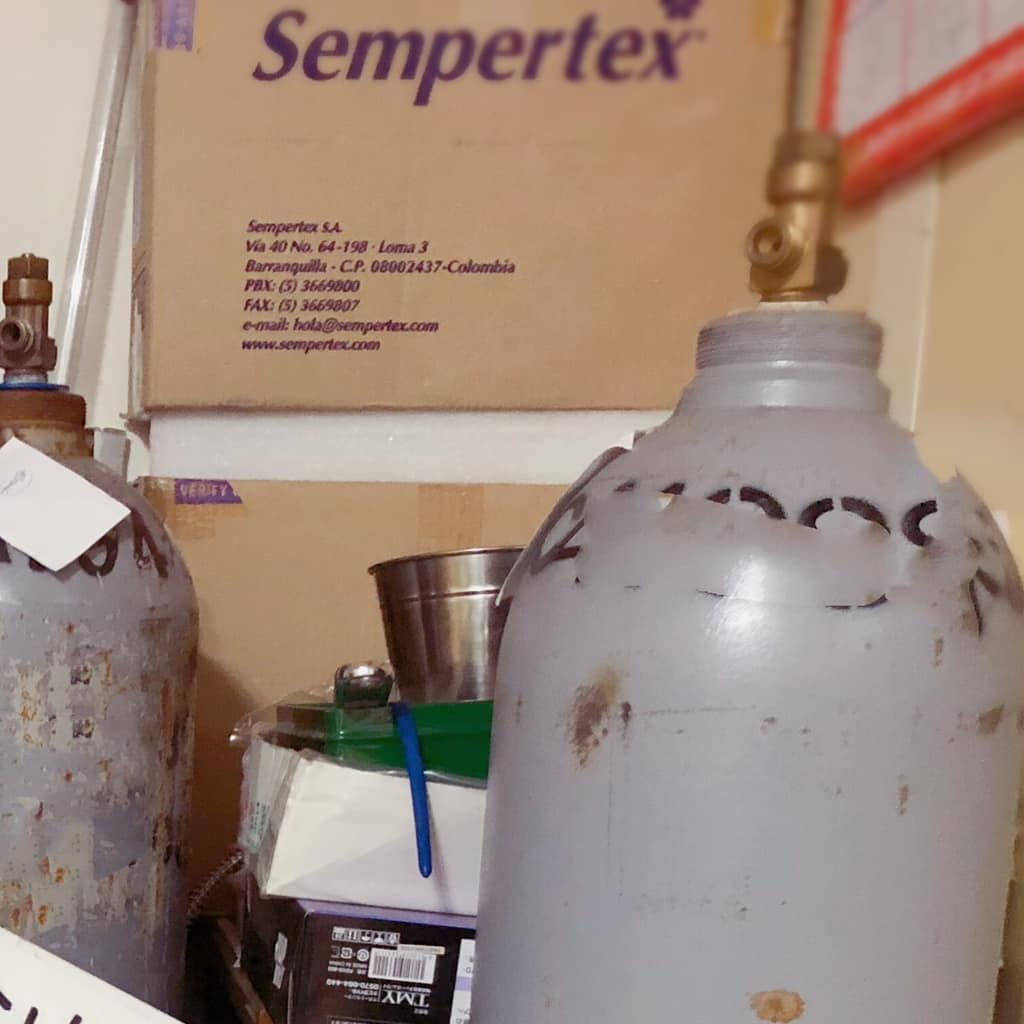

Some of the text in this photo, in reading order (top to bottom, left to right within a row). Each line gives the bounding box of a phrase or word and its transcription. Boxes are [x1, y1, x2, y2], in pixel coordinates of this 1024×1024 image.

[252, 10, 691, 106] Sempertex
[247, 219, 318, 236] Sempertex
[270, 240, 288, 253] 40
[291, 240, 314, 253] No.
[378, 240, 416, 253] Loma
[418, 240, 429, 253] 3
[245, 259, 327, 276] Barranquilla
[340, 259, 366, 273] C.P.
[244, 279, 275, 292] PBX:
[279, 279, 297, 293] (5)
[243, 299, 361, 312] FAX: (5) 3669807
[242, 318, 439, 335] e-mail: hola@sempertex.com
[242, 338, 381, 355] www.sempertex.com
[381, 989, 431, 1008] TMY
